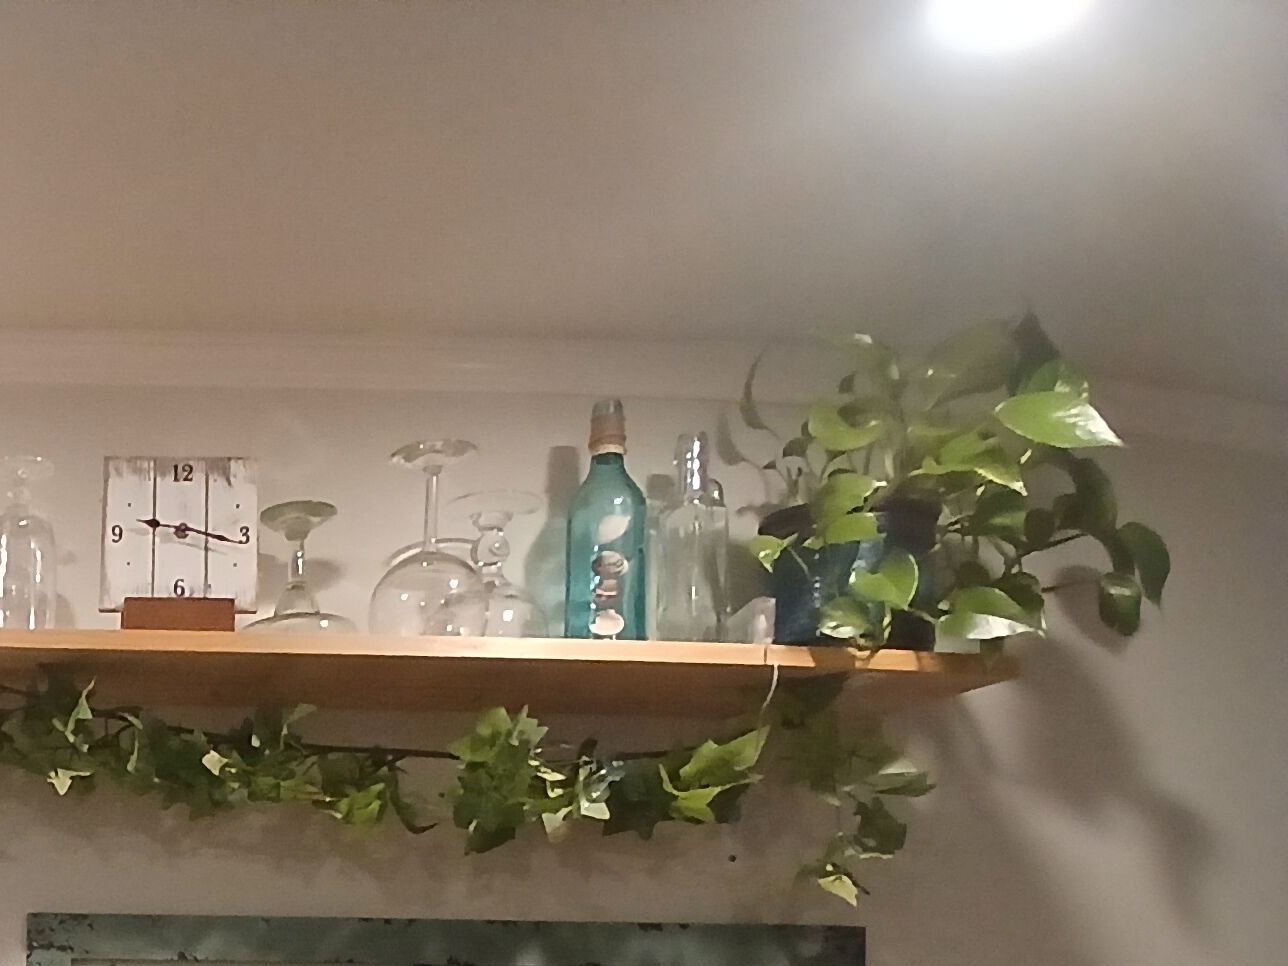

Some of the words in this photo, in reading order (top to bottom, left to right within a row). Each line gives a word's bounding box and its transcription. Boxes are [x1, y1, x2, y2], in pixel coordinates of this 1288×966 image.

[172, 464, 194, 482] 12
[111, 525, 123, 543] 9
[239, 526, 250, 544] 3
[173, 579, 185, 597] 6
